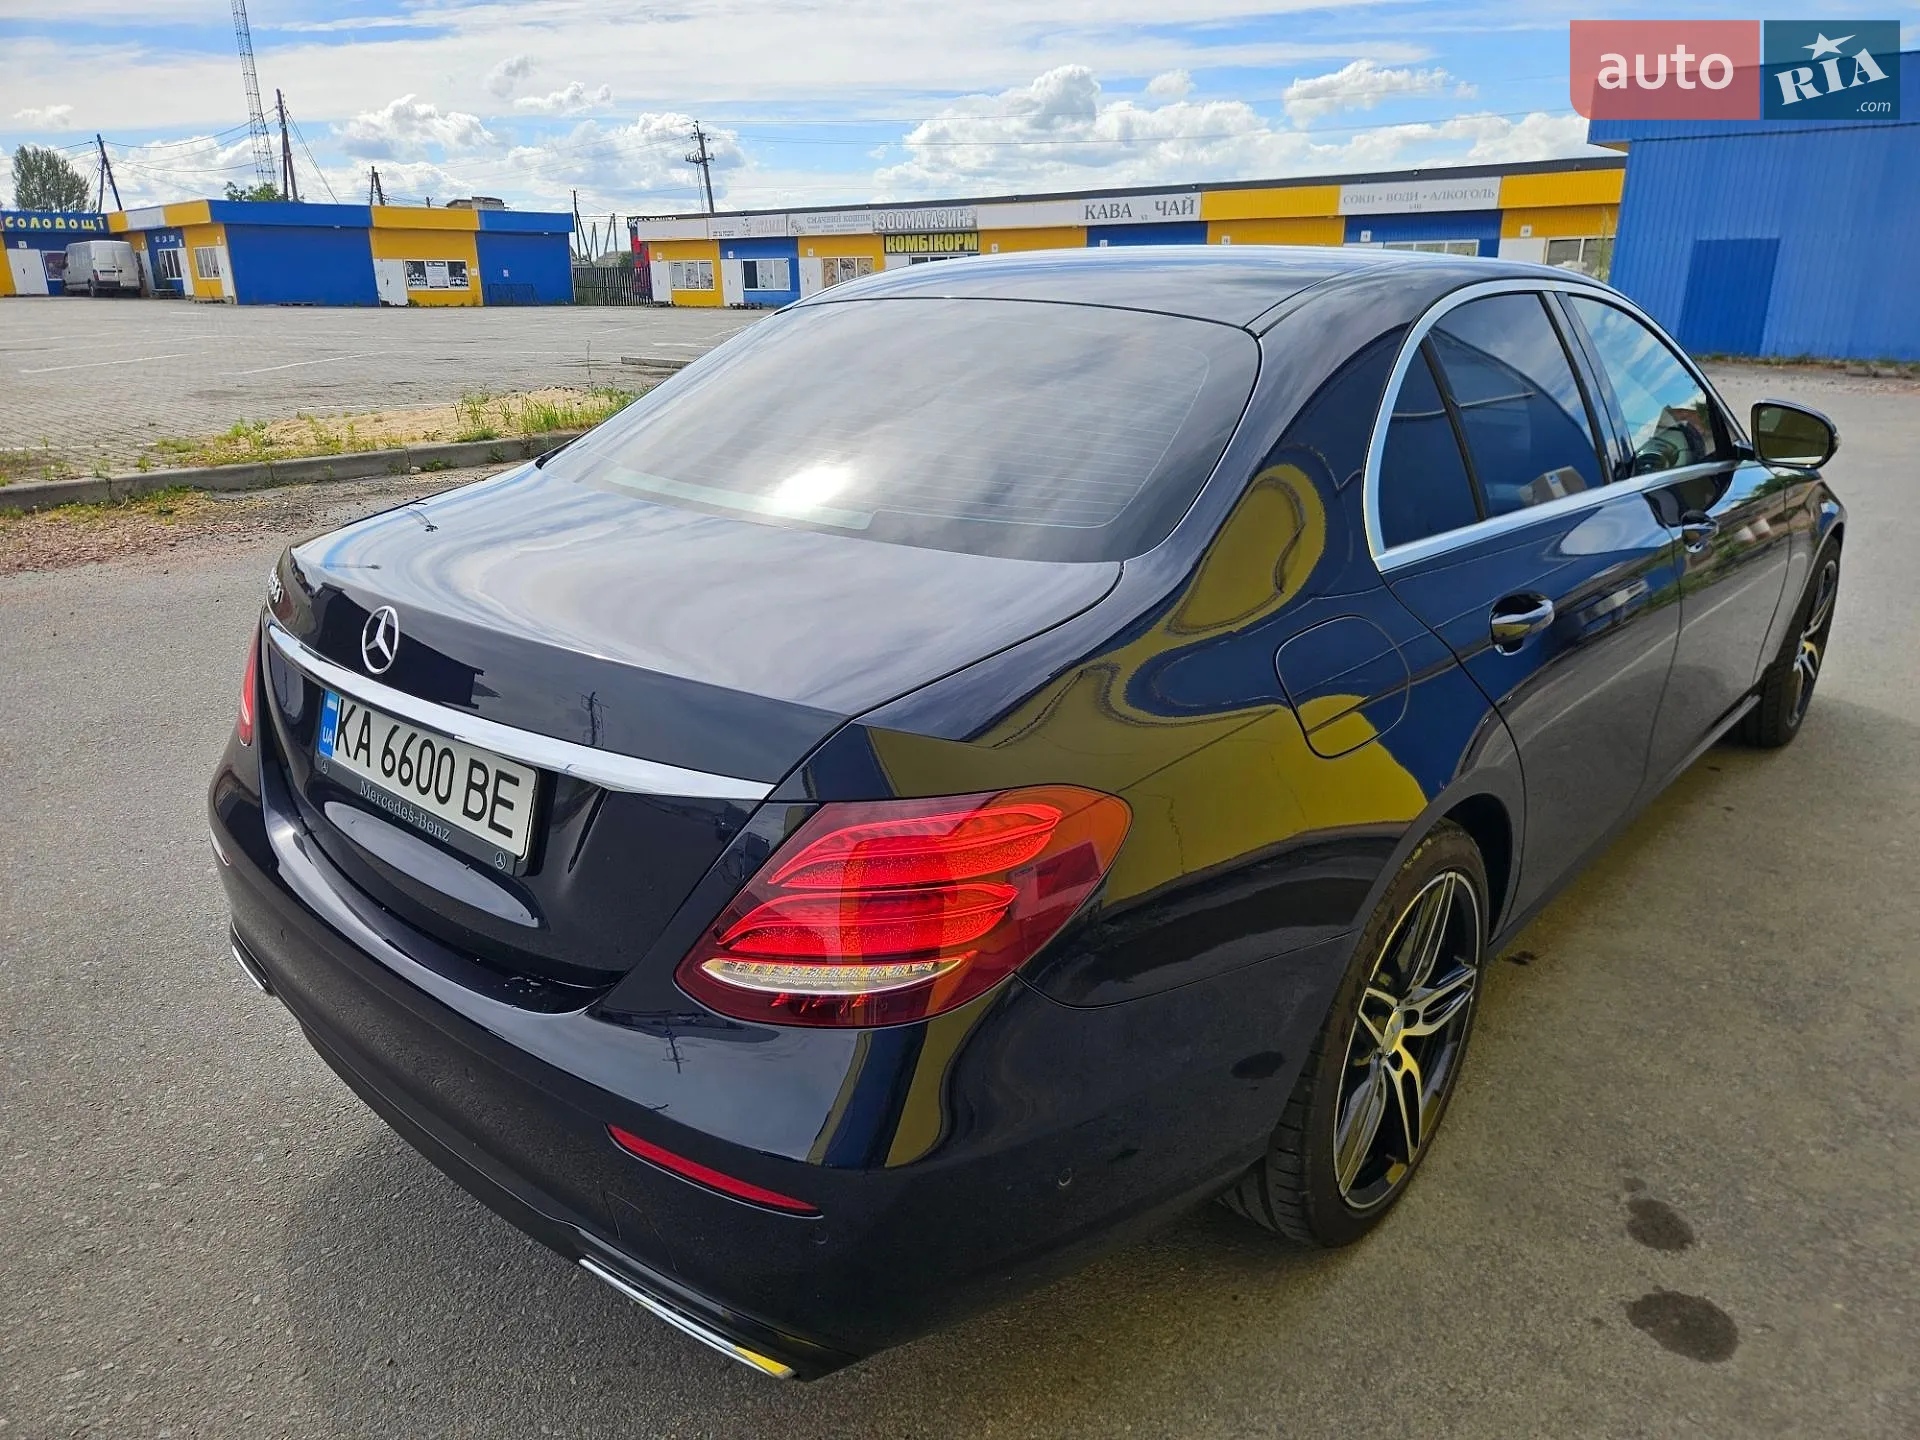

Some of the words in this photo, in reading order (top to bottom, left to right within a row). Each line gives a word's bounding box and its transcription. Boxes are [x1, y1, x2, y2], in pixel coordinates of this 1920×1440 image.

[1386, 191, 1419, 203] ВОДИ
[1430, 188, 1495, 201] АЛКОГОЛЬ
[879, 208, 966, 231] ЗООМАГАЗИН
[1084, 203, 1133, 220] КАВА
[1155, 196, 1195, 216] ЧАЙ
[885, 232, 978, 253] КОМБІКОРМ
[322, 725, 333, 746] UA
[335, 699, 372, 769] KA
[380, 725, 456, 806] 6600
[462, 757, 520, 839] BE
[359, 780, 452, 843] Mercedes-Benz
